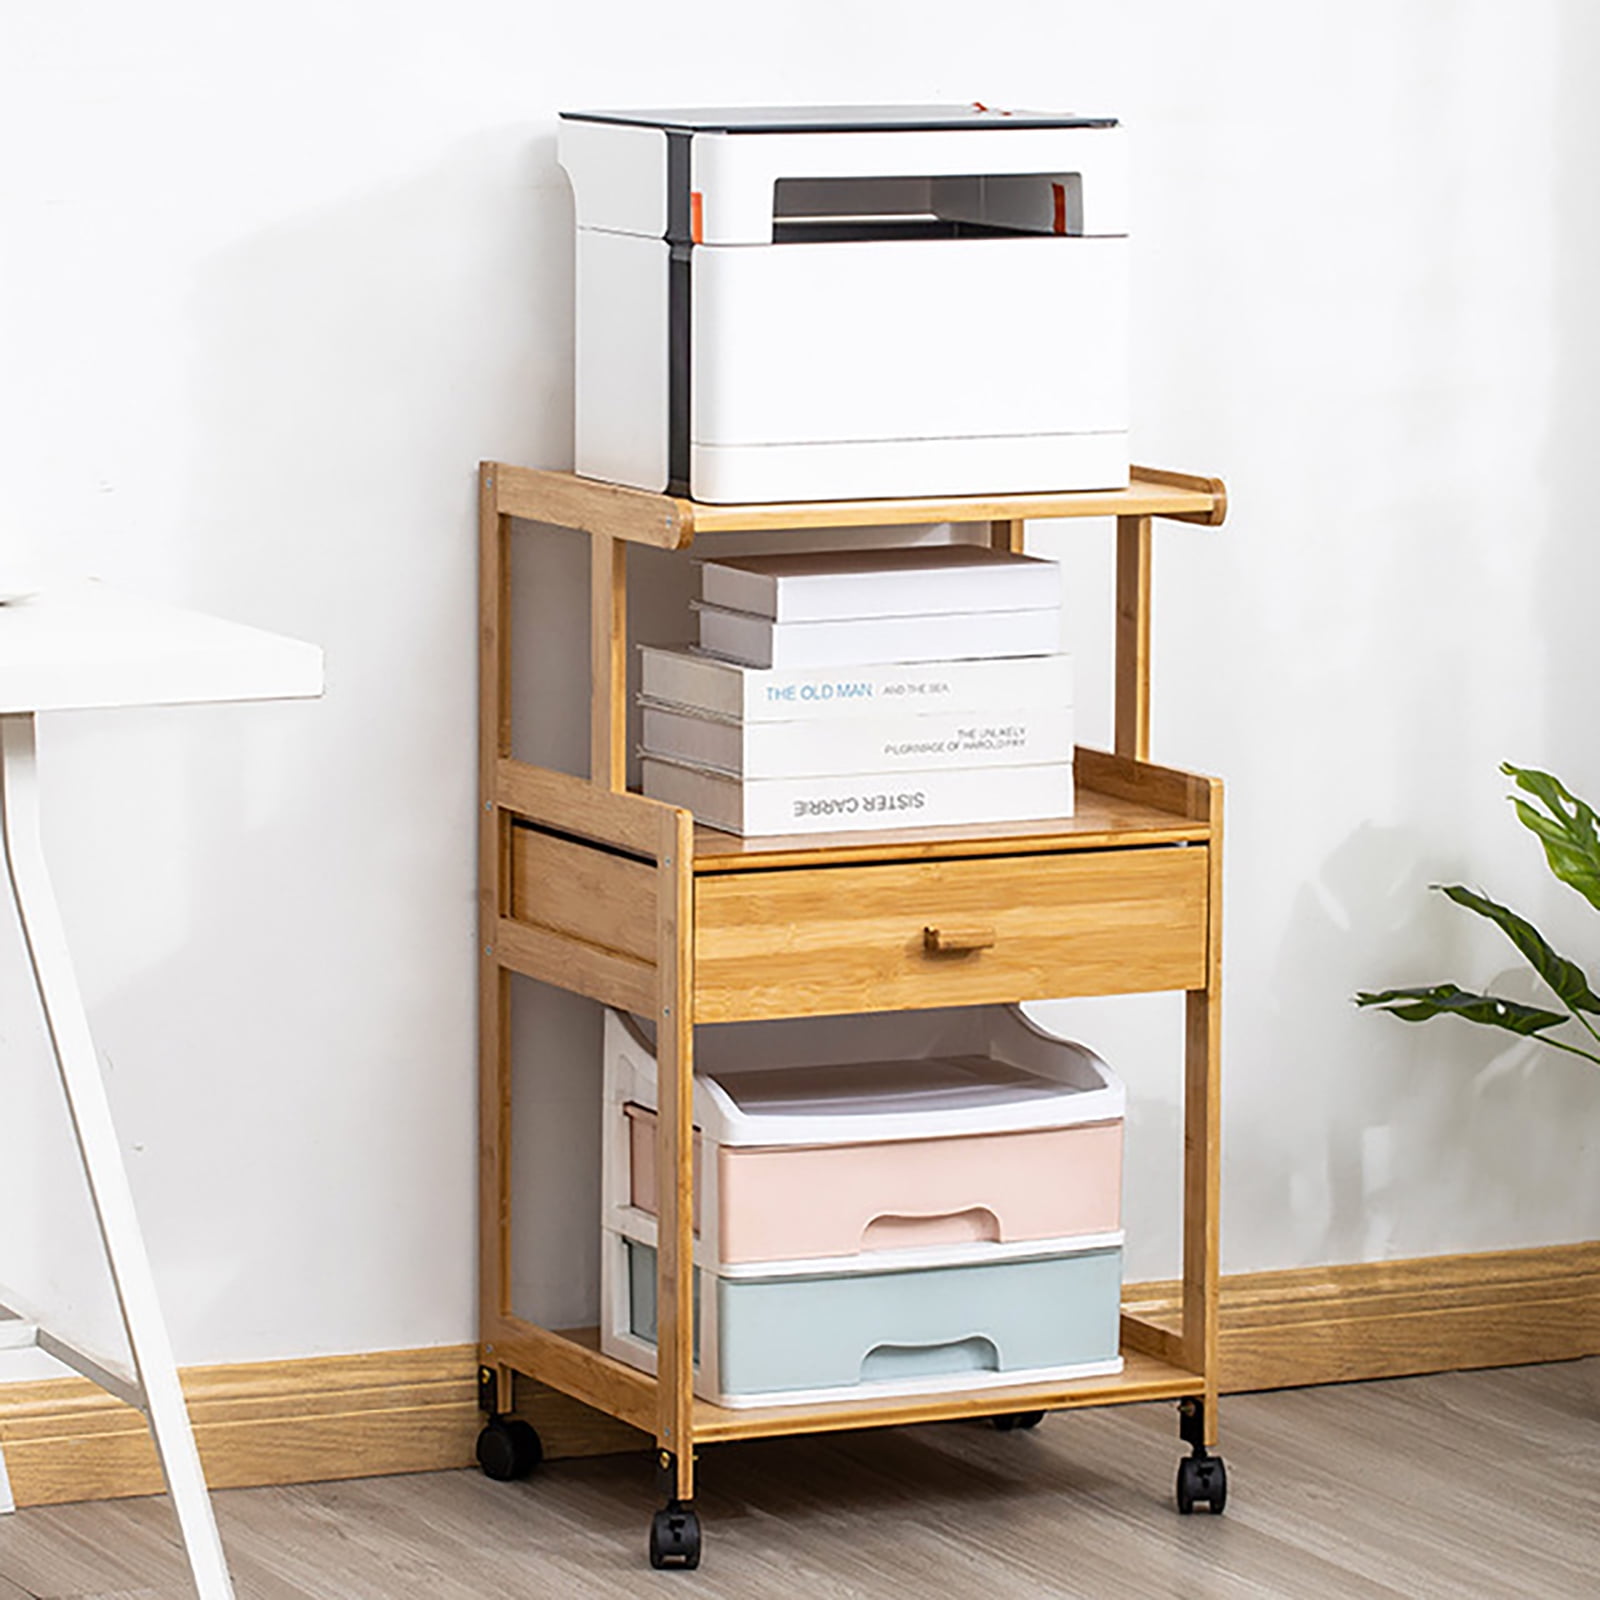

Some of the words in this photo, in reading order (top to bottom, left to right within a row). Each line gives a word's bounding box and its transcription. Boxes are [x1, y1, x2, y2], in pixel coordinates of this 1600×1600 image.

[766, 685, 796, 701] THE
[800, 684, 833, 700] OLD
[836, 683, 873, 698] MAN
[883, 684, 906, 696] AND
[906, 683, 926, 695] THE
[927, 683, 949, 695] SEA
[957, 729, 976, 739] THE
[946, 741, 960, 752] OF
[793, 797, 859, 818] CARRIE
[862, 791, 925, 812] SISTER
